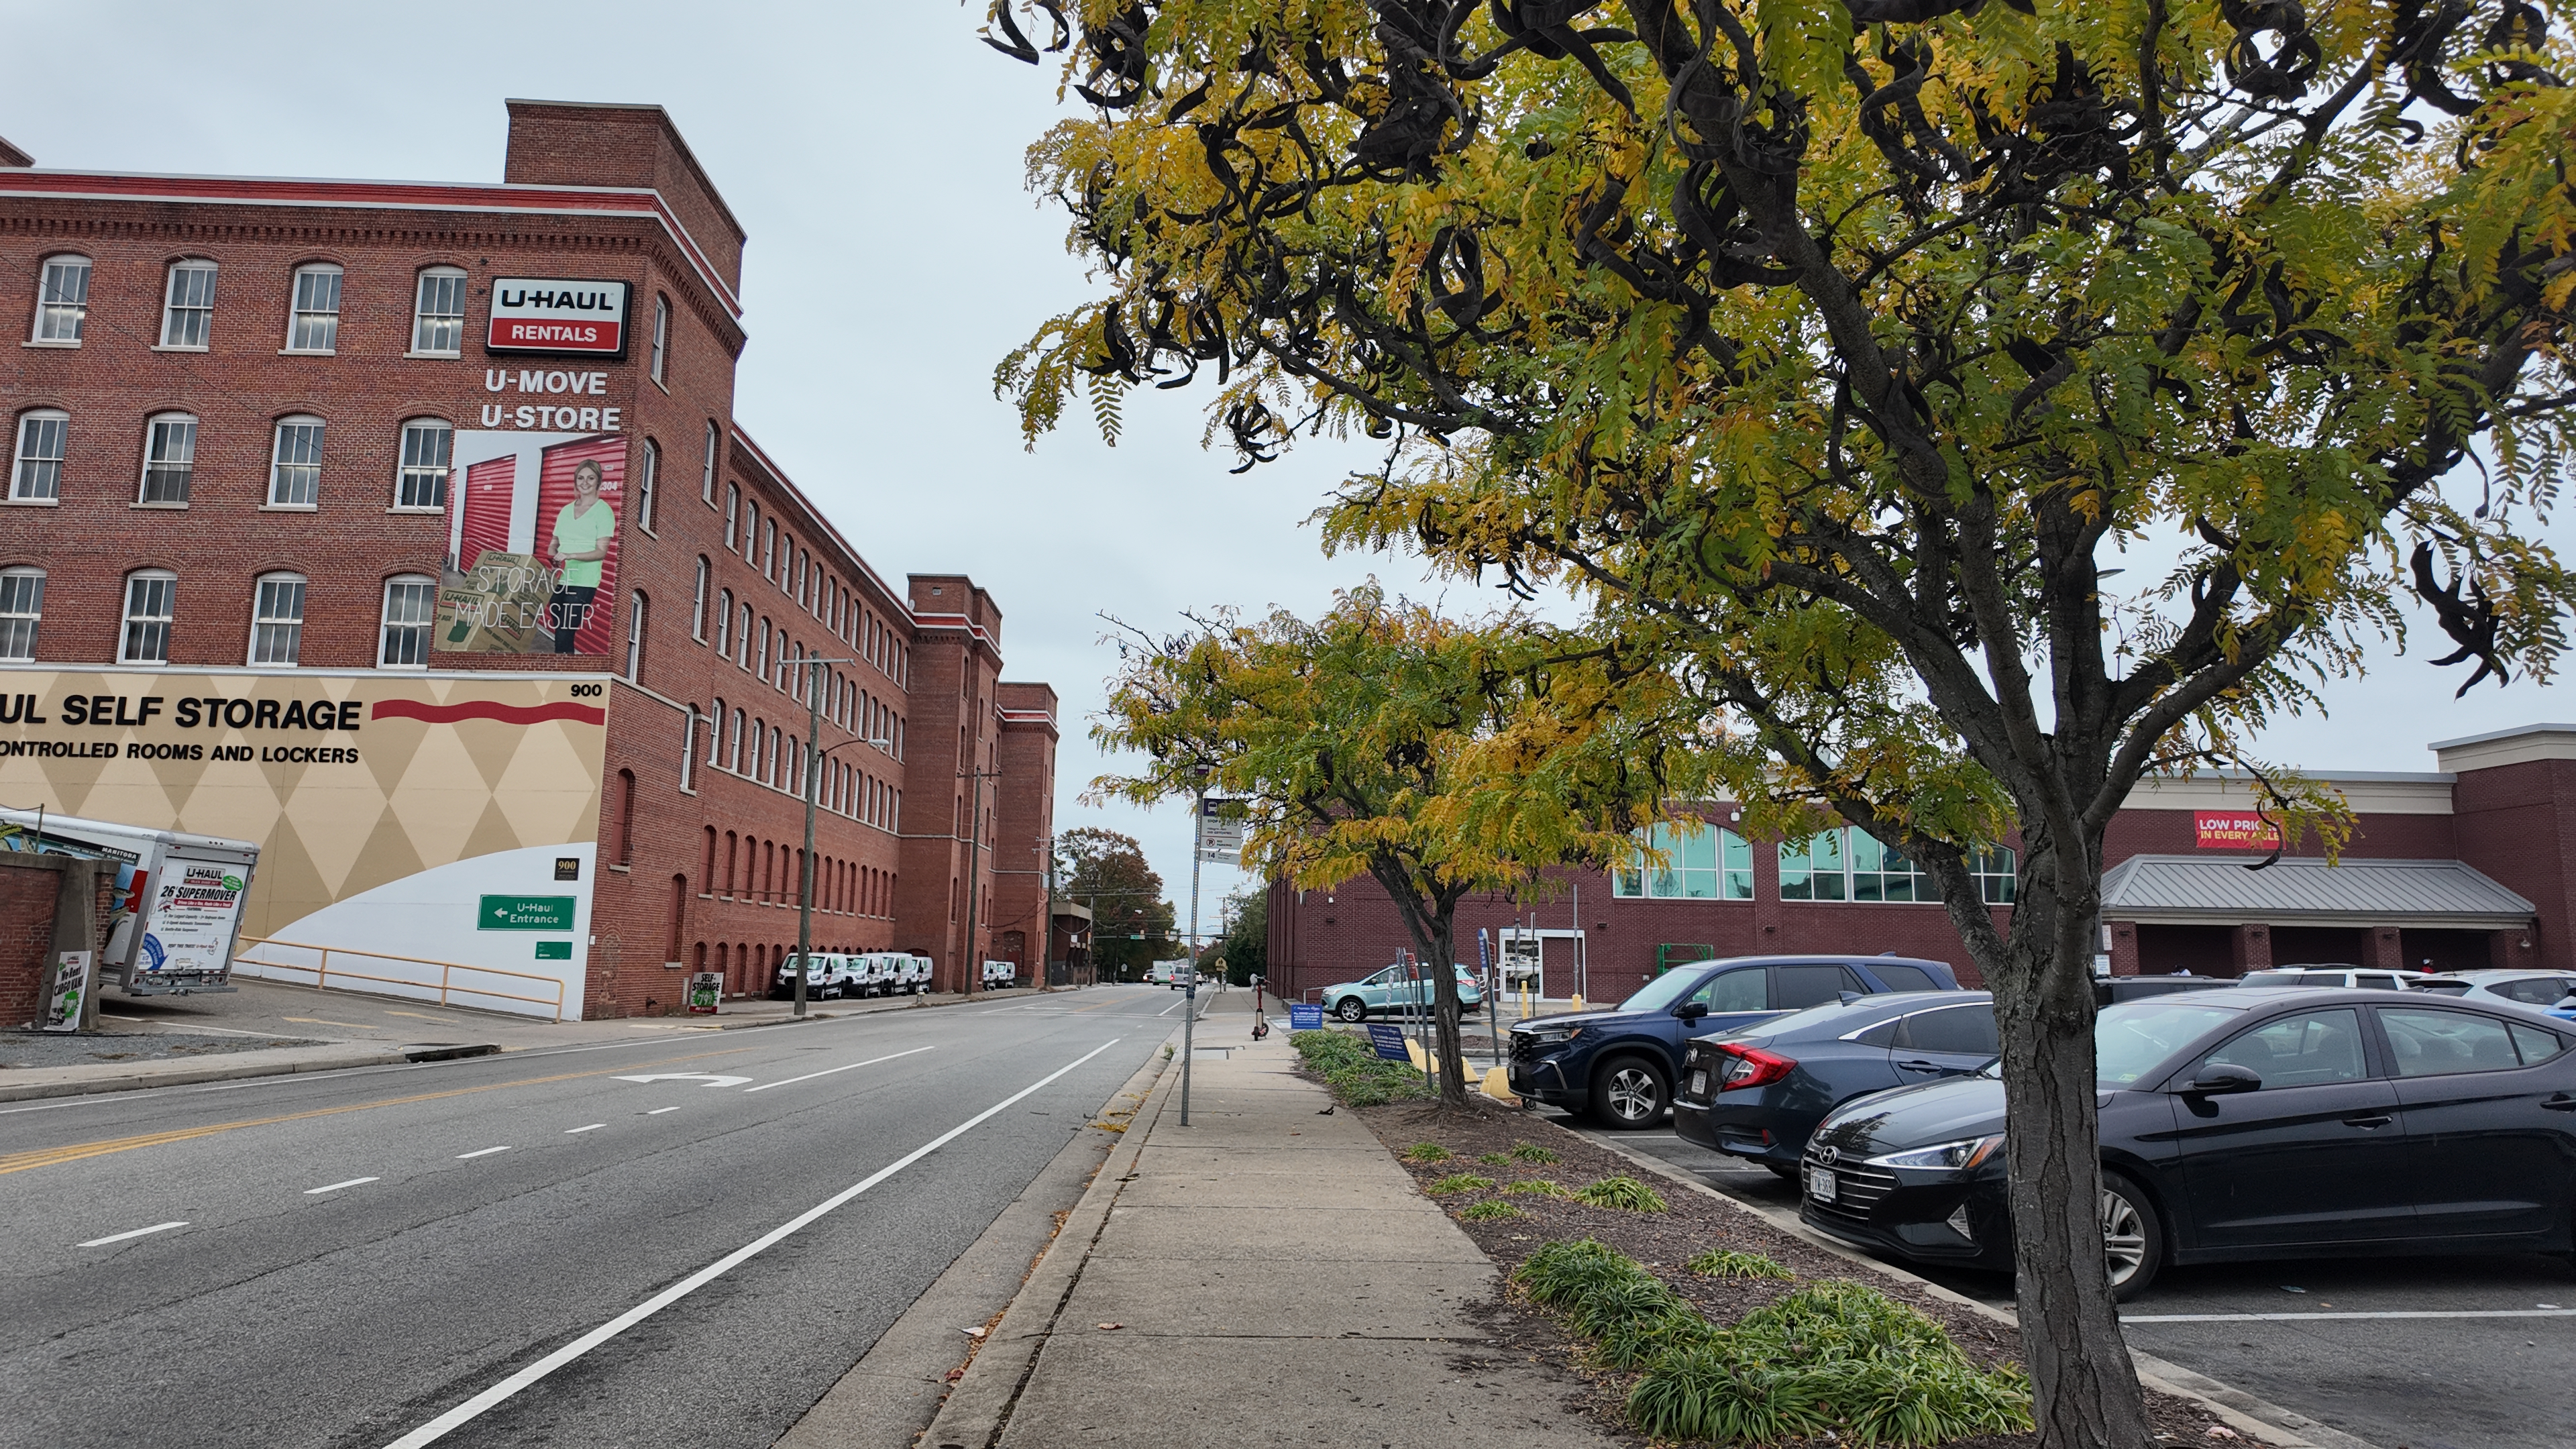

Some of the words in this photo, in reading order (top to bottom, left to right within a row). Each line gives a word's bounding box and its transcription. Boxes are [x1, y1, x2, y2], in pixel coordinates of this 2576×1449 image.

[501, 289, 613, 311] U-HAUL
[511, 325, 597, 343] RENTALS
[485, 369, 608, 394] U-MOVE
[481, 405, 621, 431] U-STORE
[477, 566, 578, 595] STORAGE
[454, 599, 512, 628] MADE
[520, 602, 594, 630] EASIER
[570, 684, 602, 697] 900
[61, 694, 164, 726] SELF
[175, 697, 362, 731] STORAGE
[127, 743, 203, 760] ROOMS
[211, 745, 254, 761] AND
[262, 746, 359, 763] LOCKERS
[2199, 819, 2230, 830] LOW
[2200, 830, 2212, 839] IN
[2214, 830, 2248, 840] EVERY
[101, 847, 138, 860] MANITOBA
[186, 867, 223, 879] U-HAUL
[558, 861, 576, 870] 900
[176, 886, 237, 901] SUPERMOVER
[517, 903, 553, 912] U-Haul
[509, 914, 559, 924] Entrance
[54, 979, 71, 997] CARGO
[692, 982, 720, 991] STORAGE
